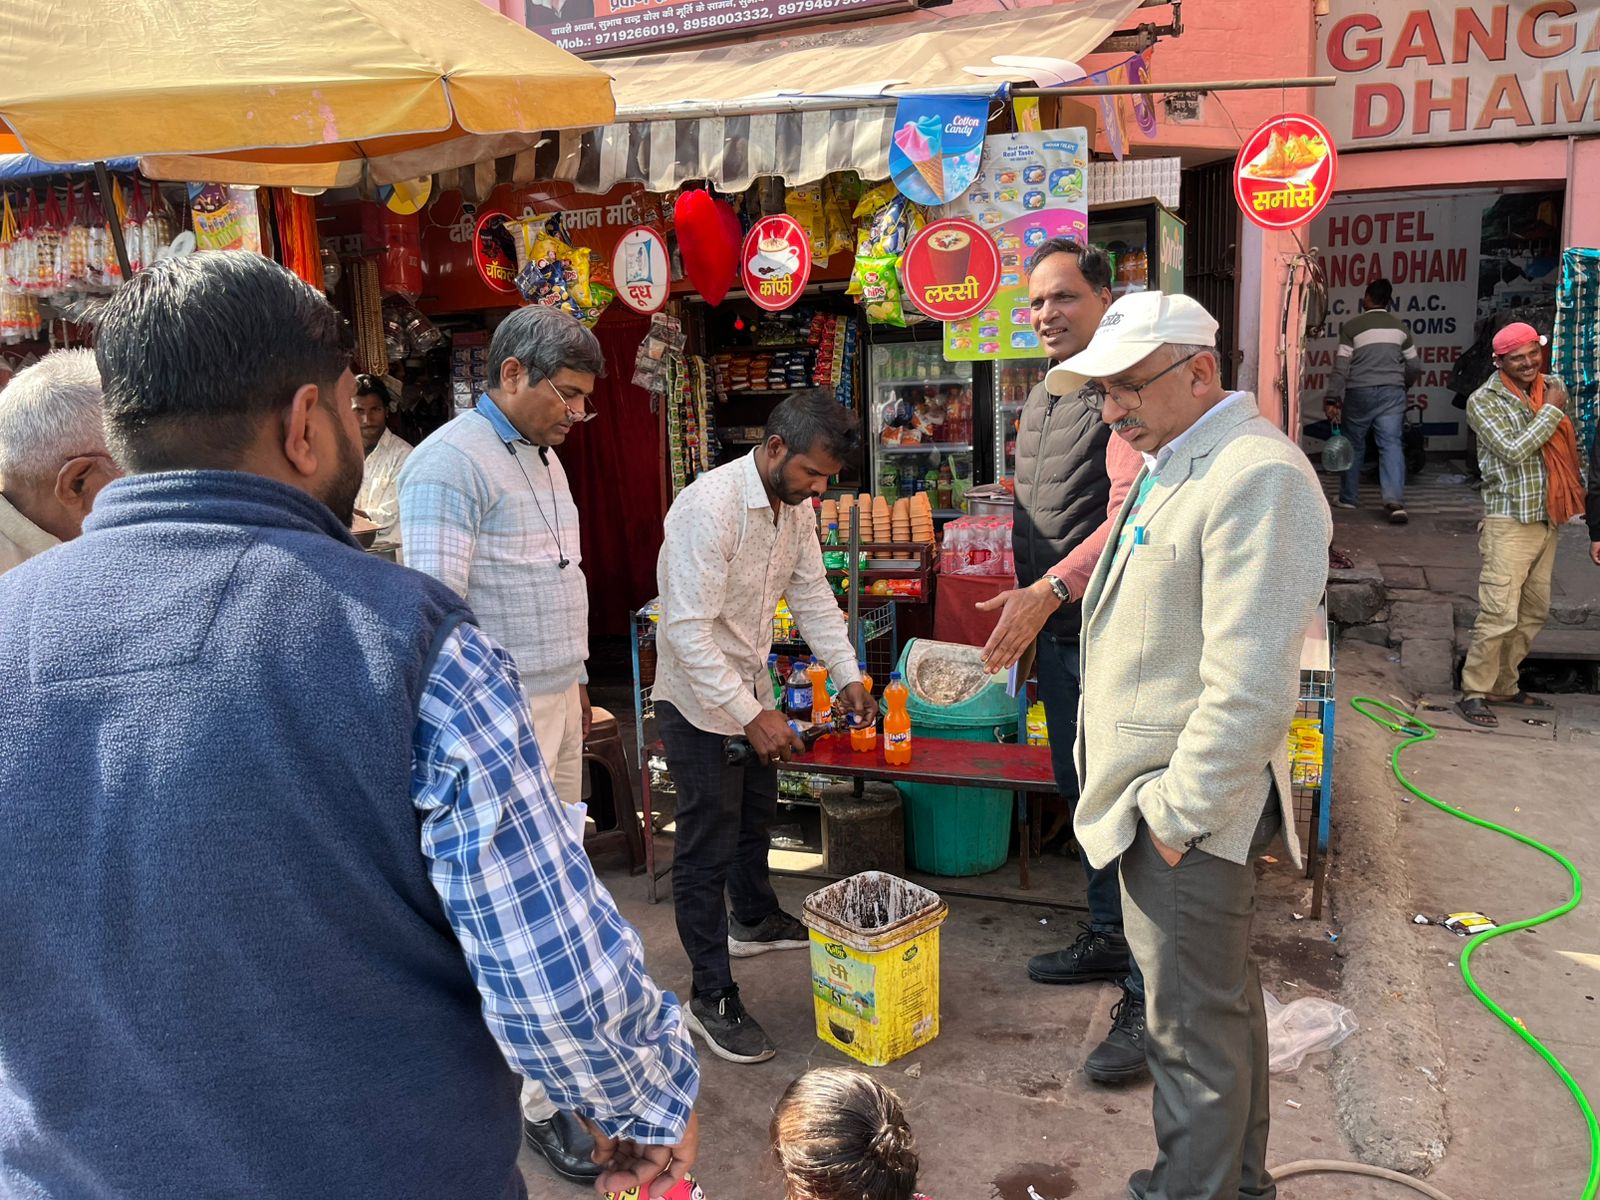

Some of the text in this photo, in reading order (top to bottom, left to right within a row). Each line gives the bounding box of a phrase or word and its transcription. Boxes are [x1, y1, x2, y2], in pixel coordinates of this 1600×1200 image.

[662, 7, 674, 18] की
[555, 37, 592, 50] Mob.:
[683, 7, 773, 31] 8958003332,
[1352, 66, 1600, 140] DHAM
[944, 123, 974, 137] Candy
[953, 115, 979, 126] Cotton
[1252, 179, 1317, 211] समोसे
[1328, 211, 1434, 247] HOTEL
[1161, 225, 1183, 273] Sprite
[1392, 248, 1467, 284] DHAM
[627, 285, 652, 306] दूध
[759, 273, 793, 296] कॉफी
[923, 275, 980, 304] लस्सी
[1407, 295, 1446, 313] A.C.
[889, 732, 907, 743] FANTA
[829, 963, 848, 981] घी
[901, 962, 921, 979] Ghee
